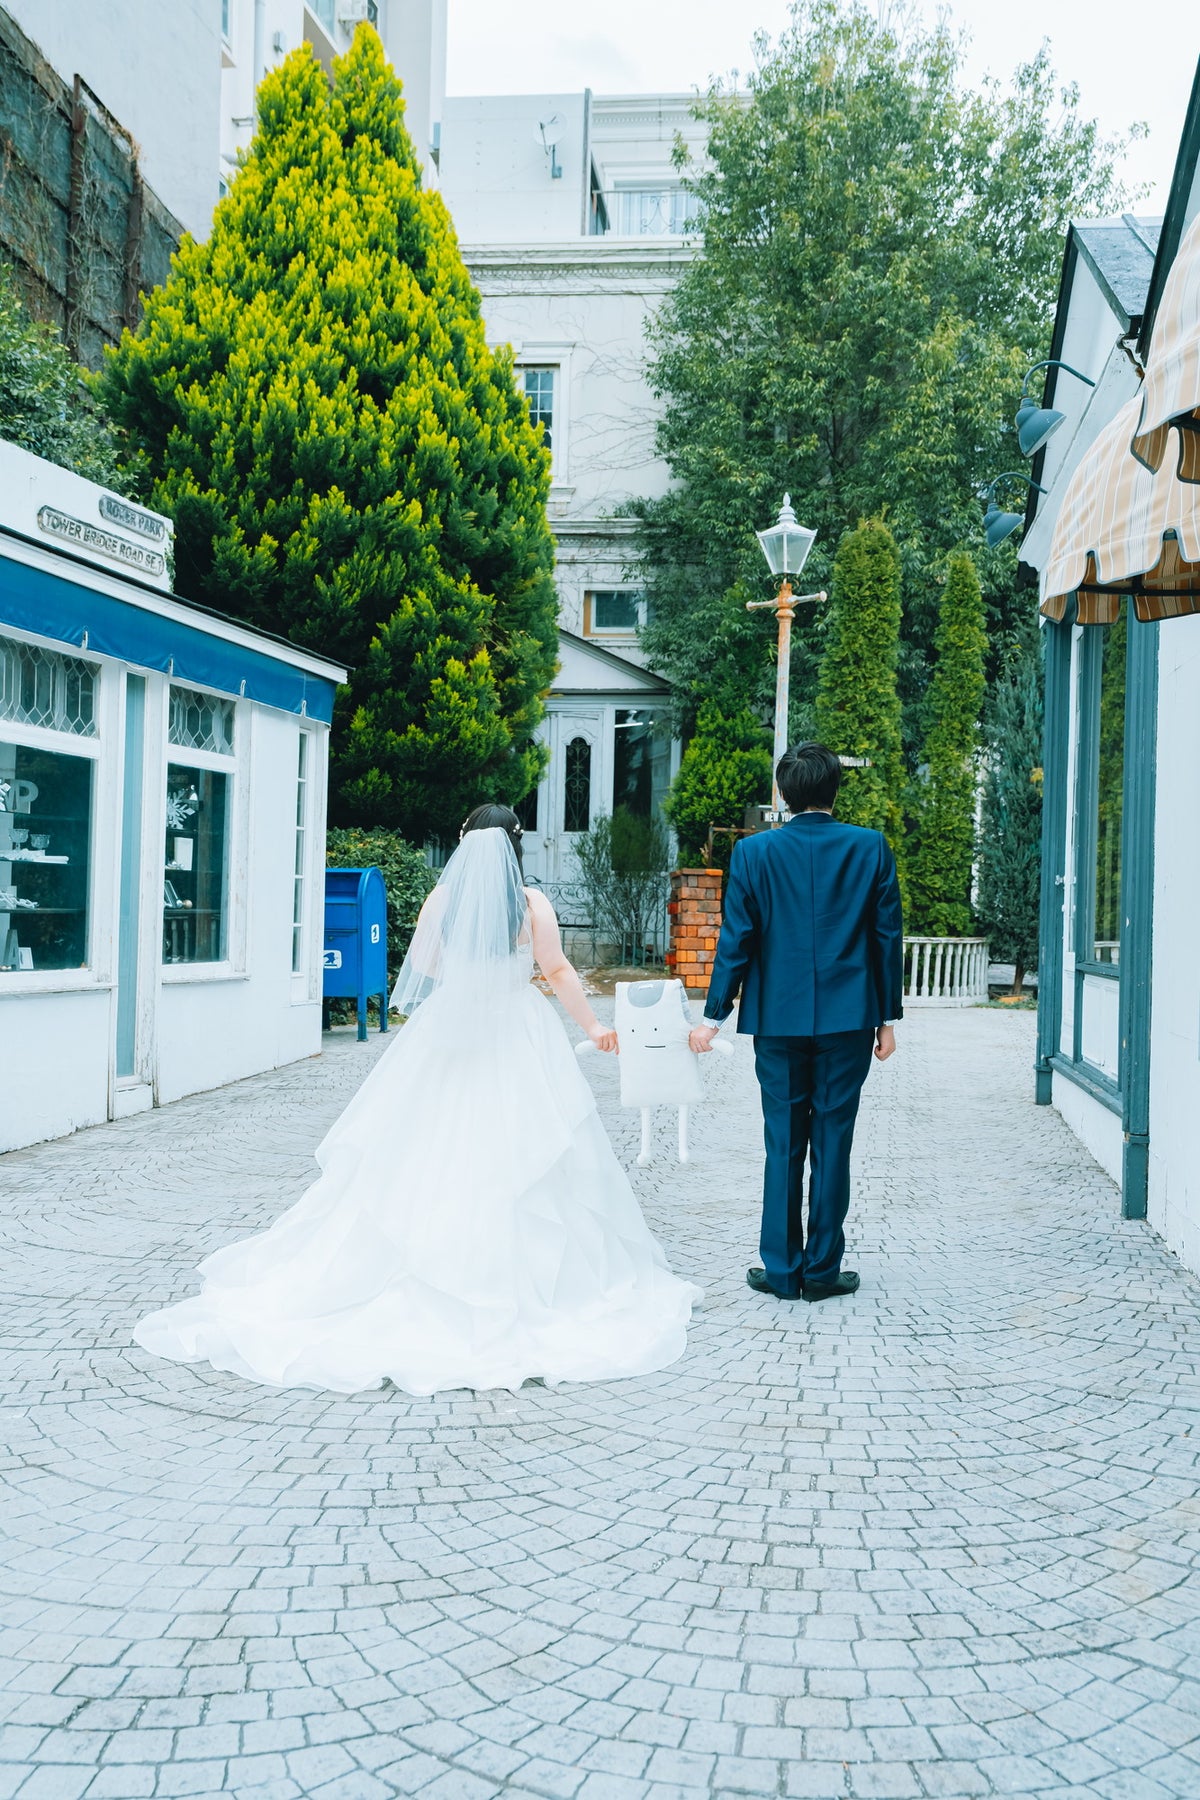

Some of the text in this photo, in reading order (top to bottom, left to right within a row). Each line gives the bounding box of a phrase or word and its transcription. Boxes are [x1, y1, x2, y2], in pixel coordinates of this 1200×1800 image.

[45, 511, 82, 540] TOWER
[84, 527, 118, 553] BRIDGE
[119, 542, 144, 563] ROAD
[138, 514, 162, 538] PARK
[764, 811, 779, 822] NEW
